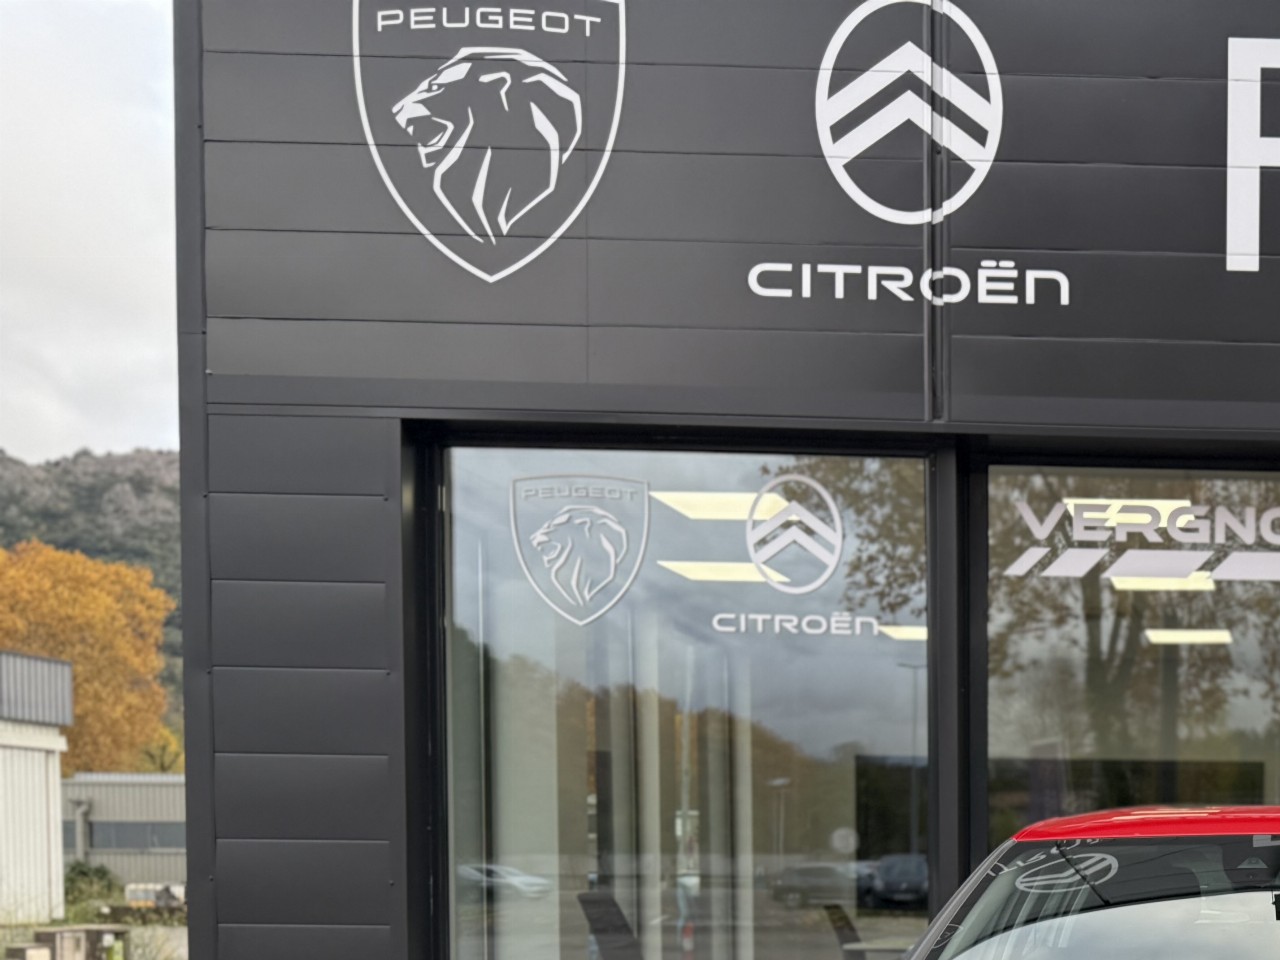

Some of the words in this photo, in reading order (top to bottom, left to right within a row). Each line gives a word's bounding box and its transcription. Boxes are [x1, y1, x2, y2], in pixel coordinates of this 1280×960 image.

[376, 6, 602, 37] PEUGEOT
[747, 260, 1071, 306] CITROËN
[520, 483, 640, 501] PEUGEOT
[711, 612, 880, 637] CITROËN
